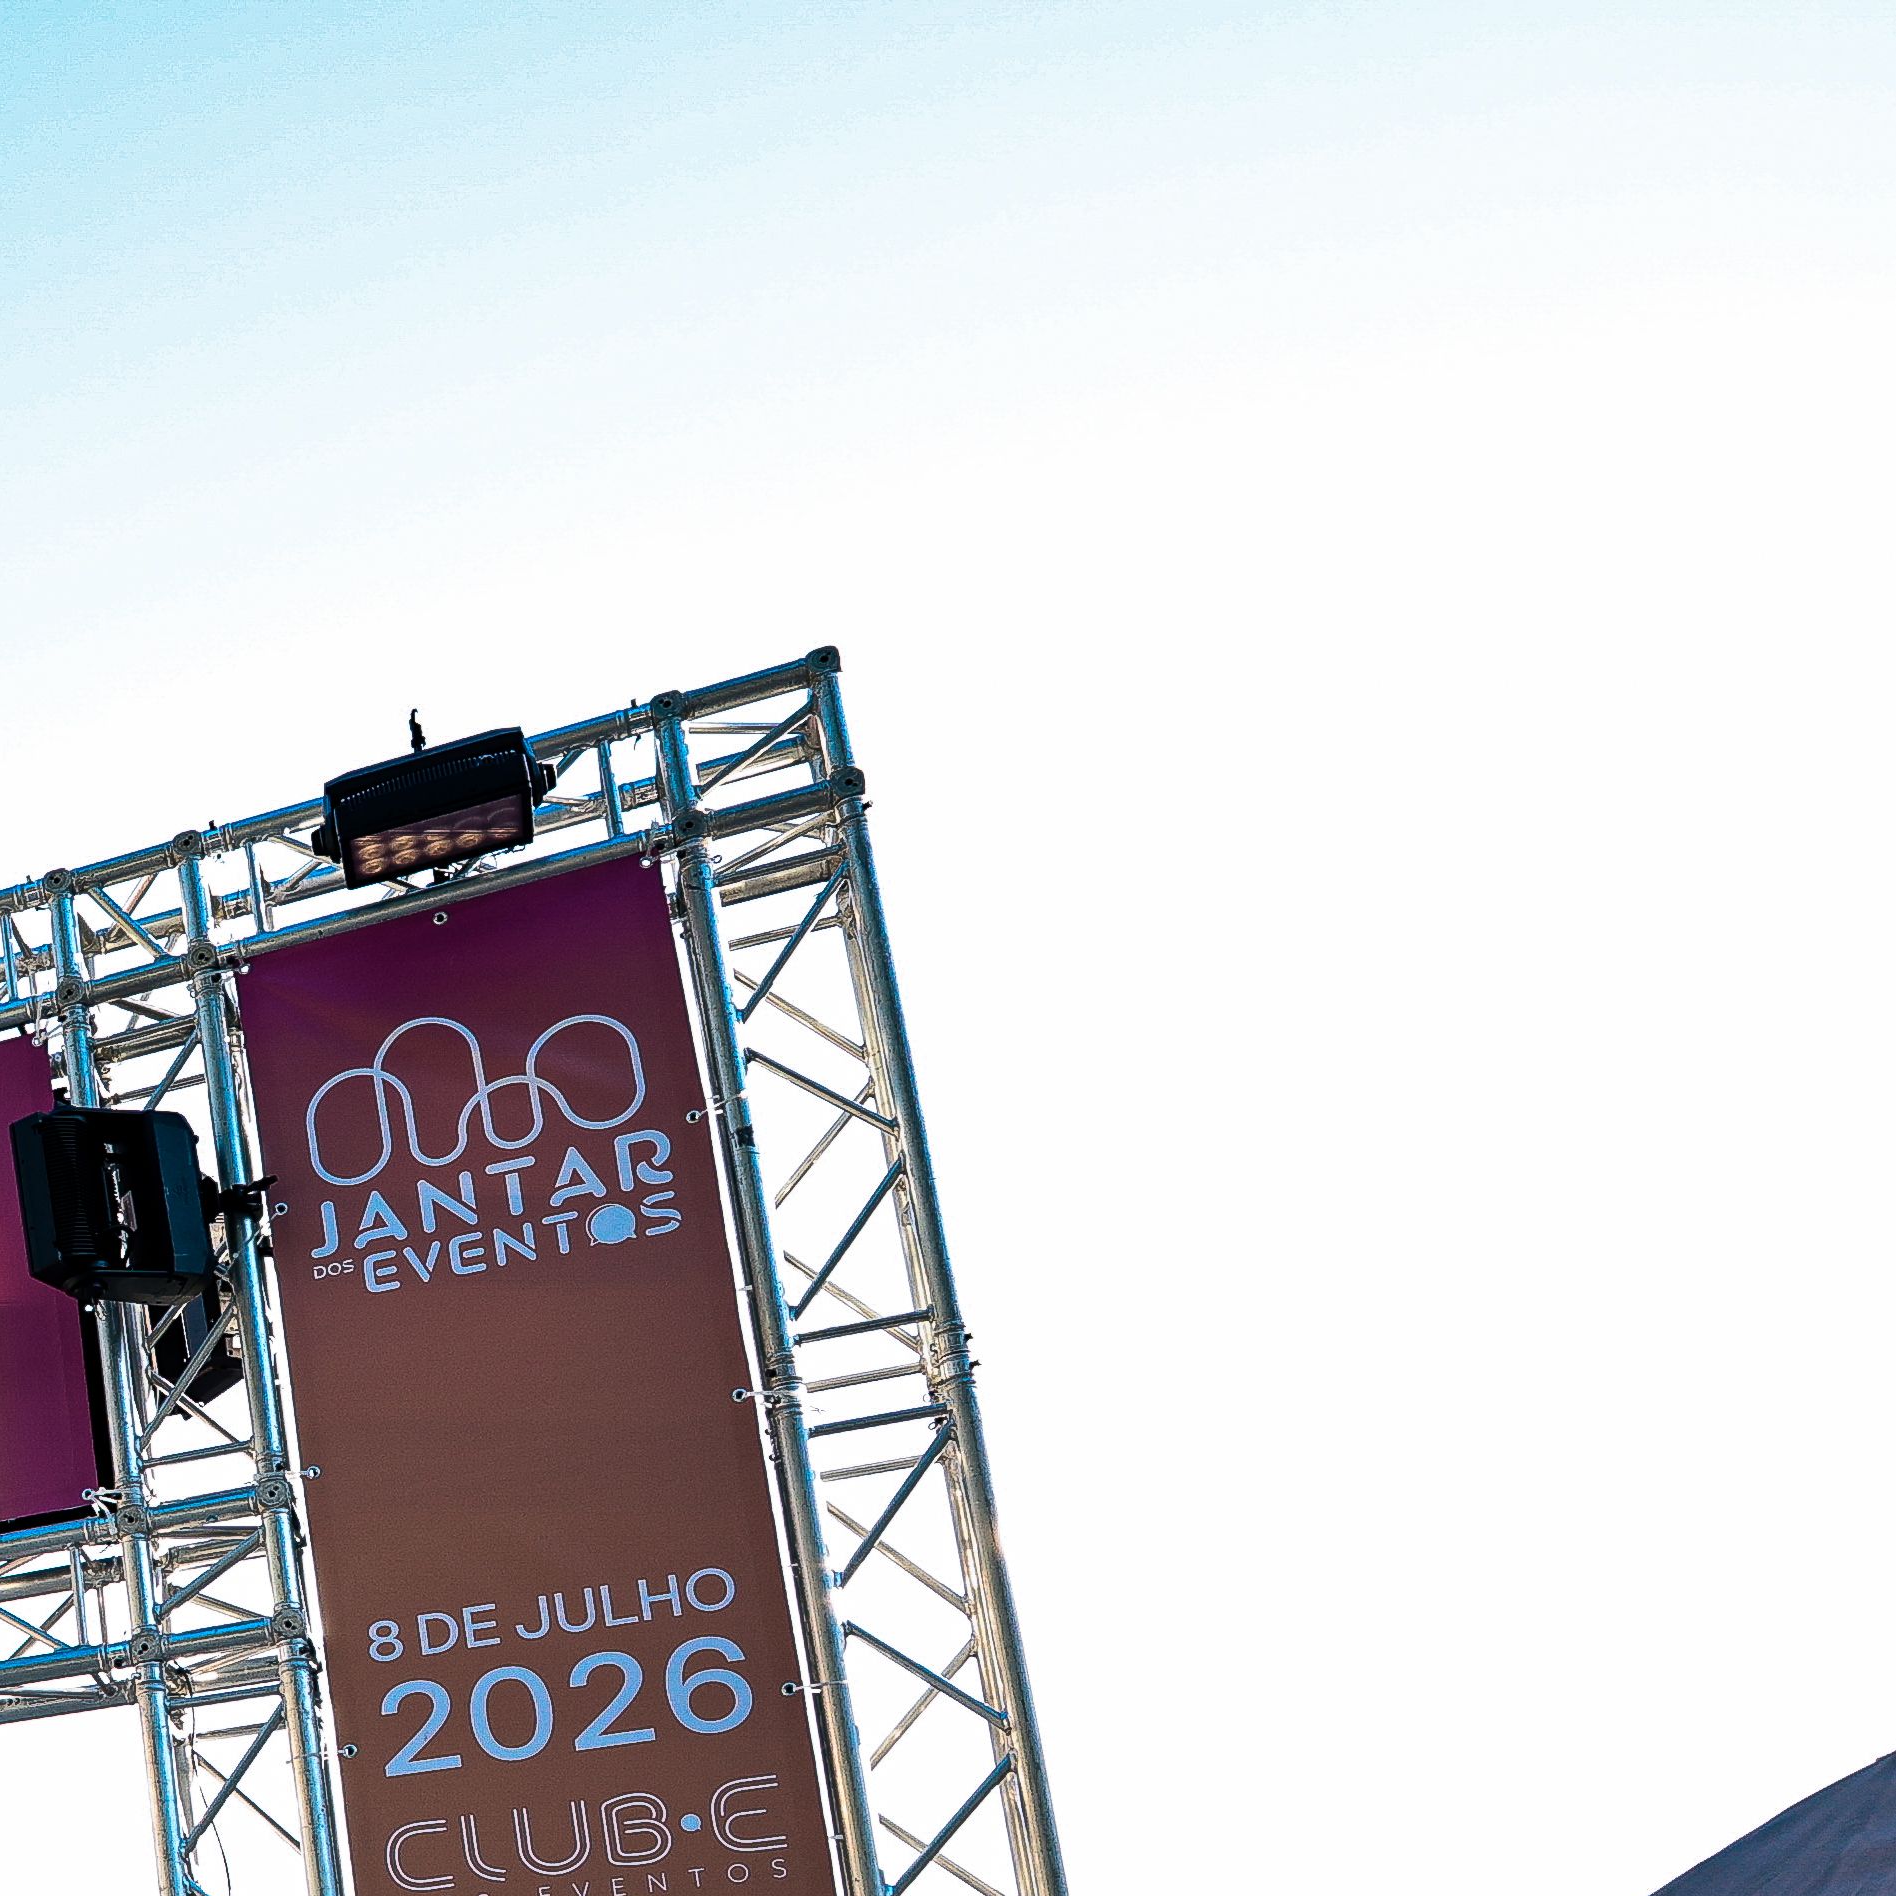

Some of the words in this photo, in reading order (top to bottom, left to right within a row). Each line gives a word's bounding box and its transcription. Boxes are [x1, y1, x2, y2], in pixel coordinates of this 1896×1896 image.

[311, 1129, 674, 1259] JANTAR
[312, 1257, 356, 1280] DOS
[363, 1190, 683, 1294] EVENTOS
[367, 1619, 405, 1662] 8
[417, 1603, 502, 1656] DE
[515, 1567, 737, 1641] JULHO
[380, 1635, 754, 1778] 2026
